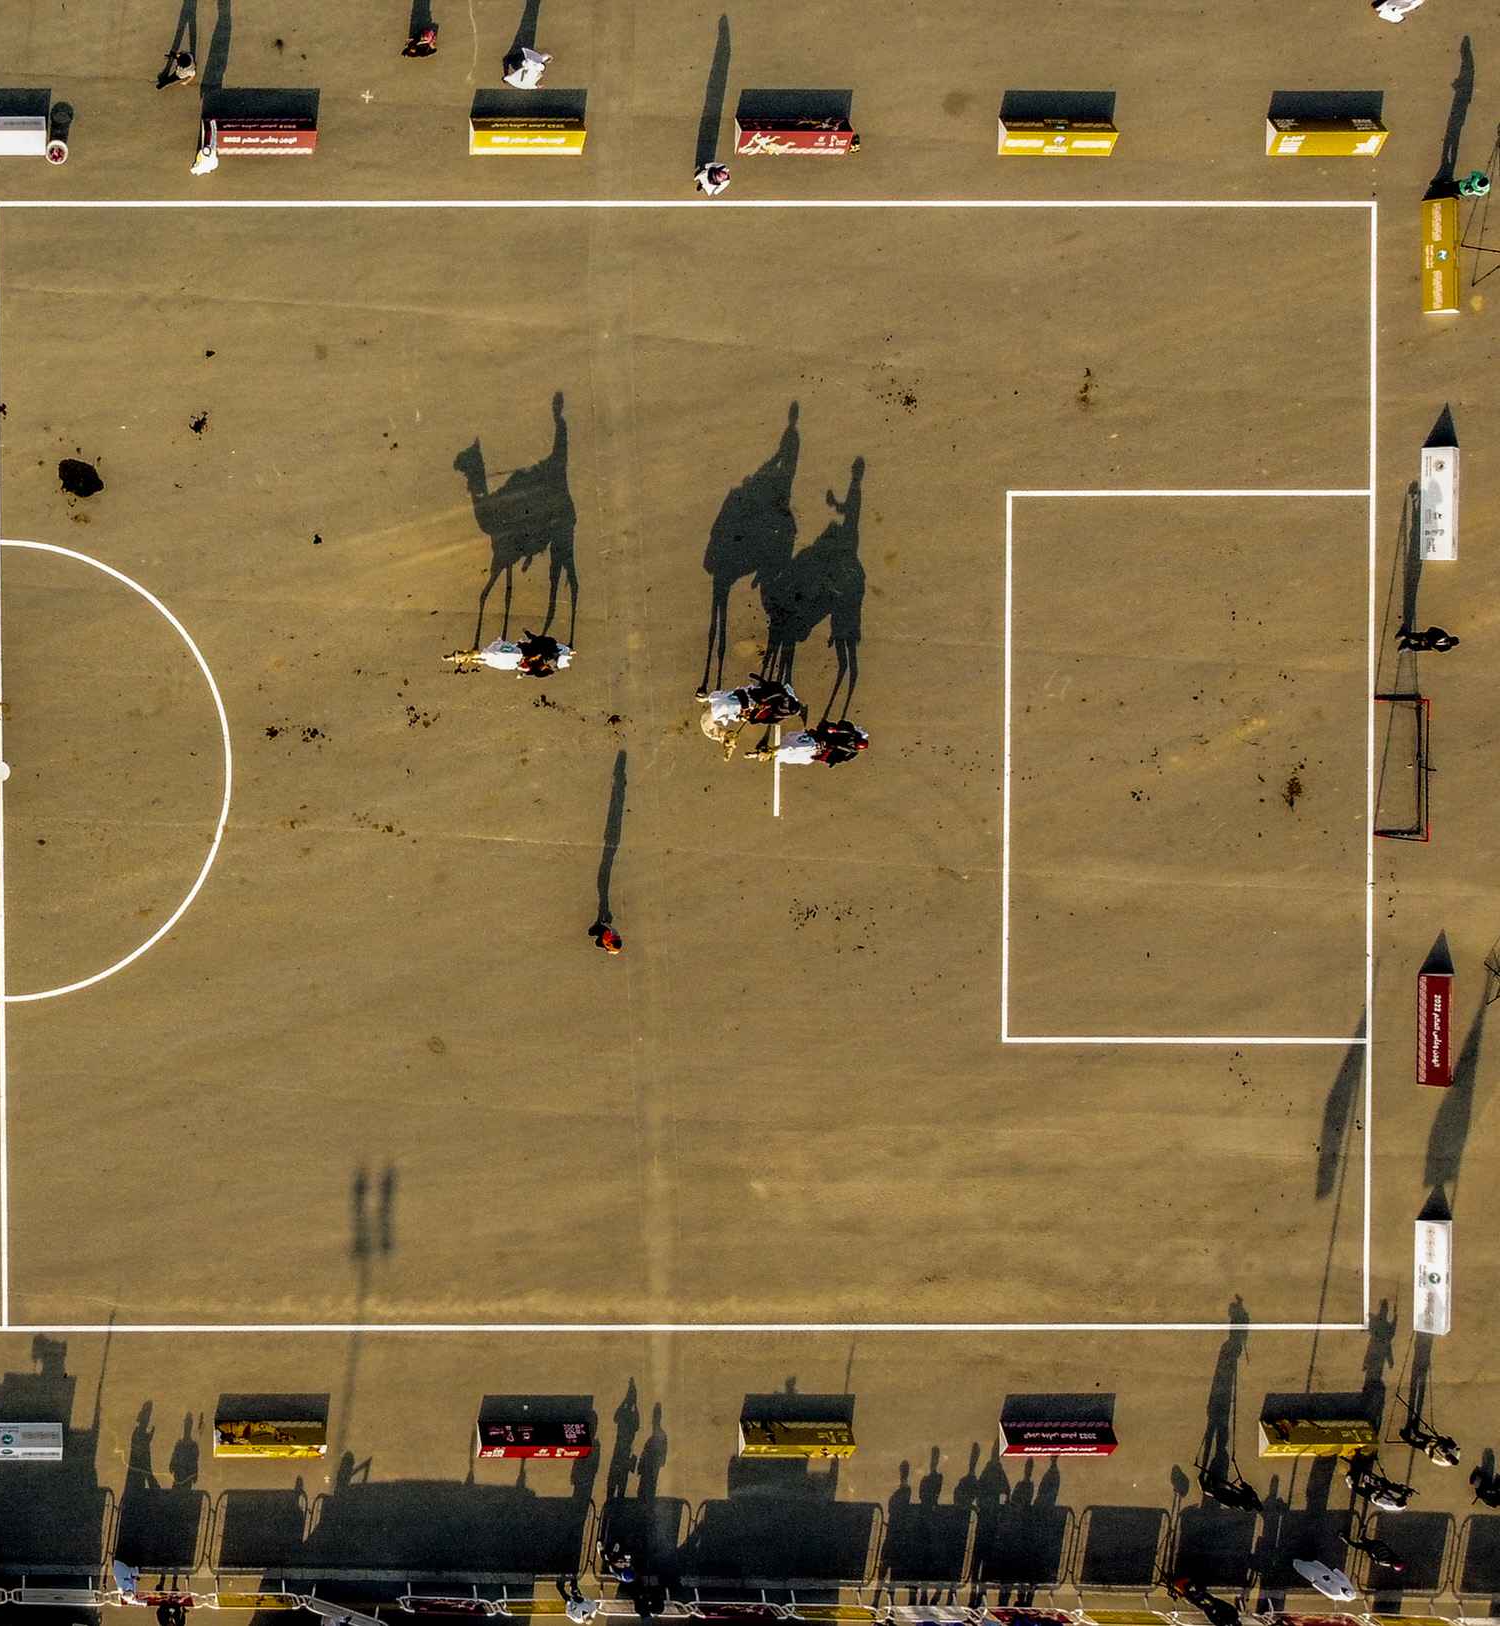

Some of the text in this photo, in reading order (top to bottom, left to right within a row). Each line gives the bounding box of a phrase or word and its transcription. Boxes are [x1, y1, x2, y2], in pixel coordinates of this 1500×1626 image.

[1431, 994, 1442, 1067] الهجن وكأس العالم 2022
